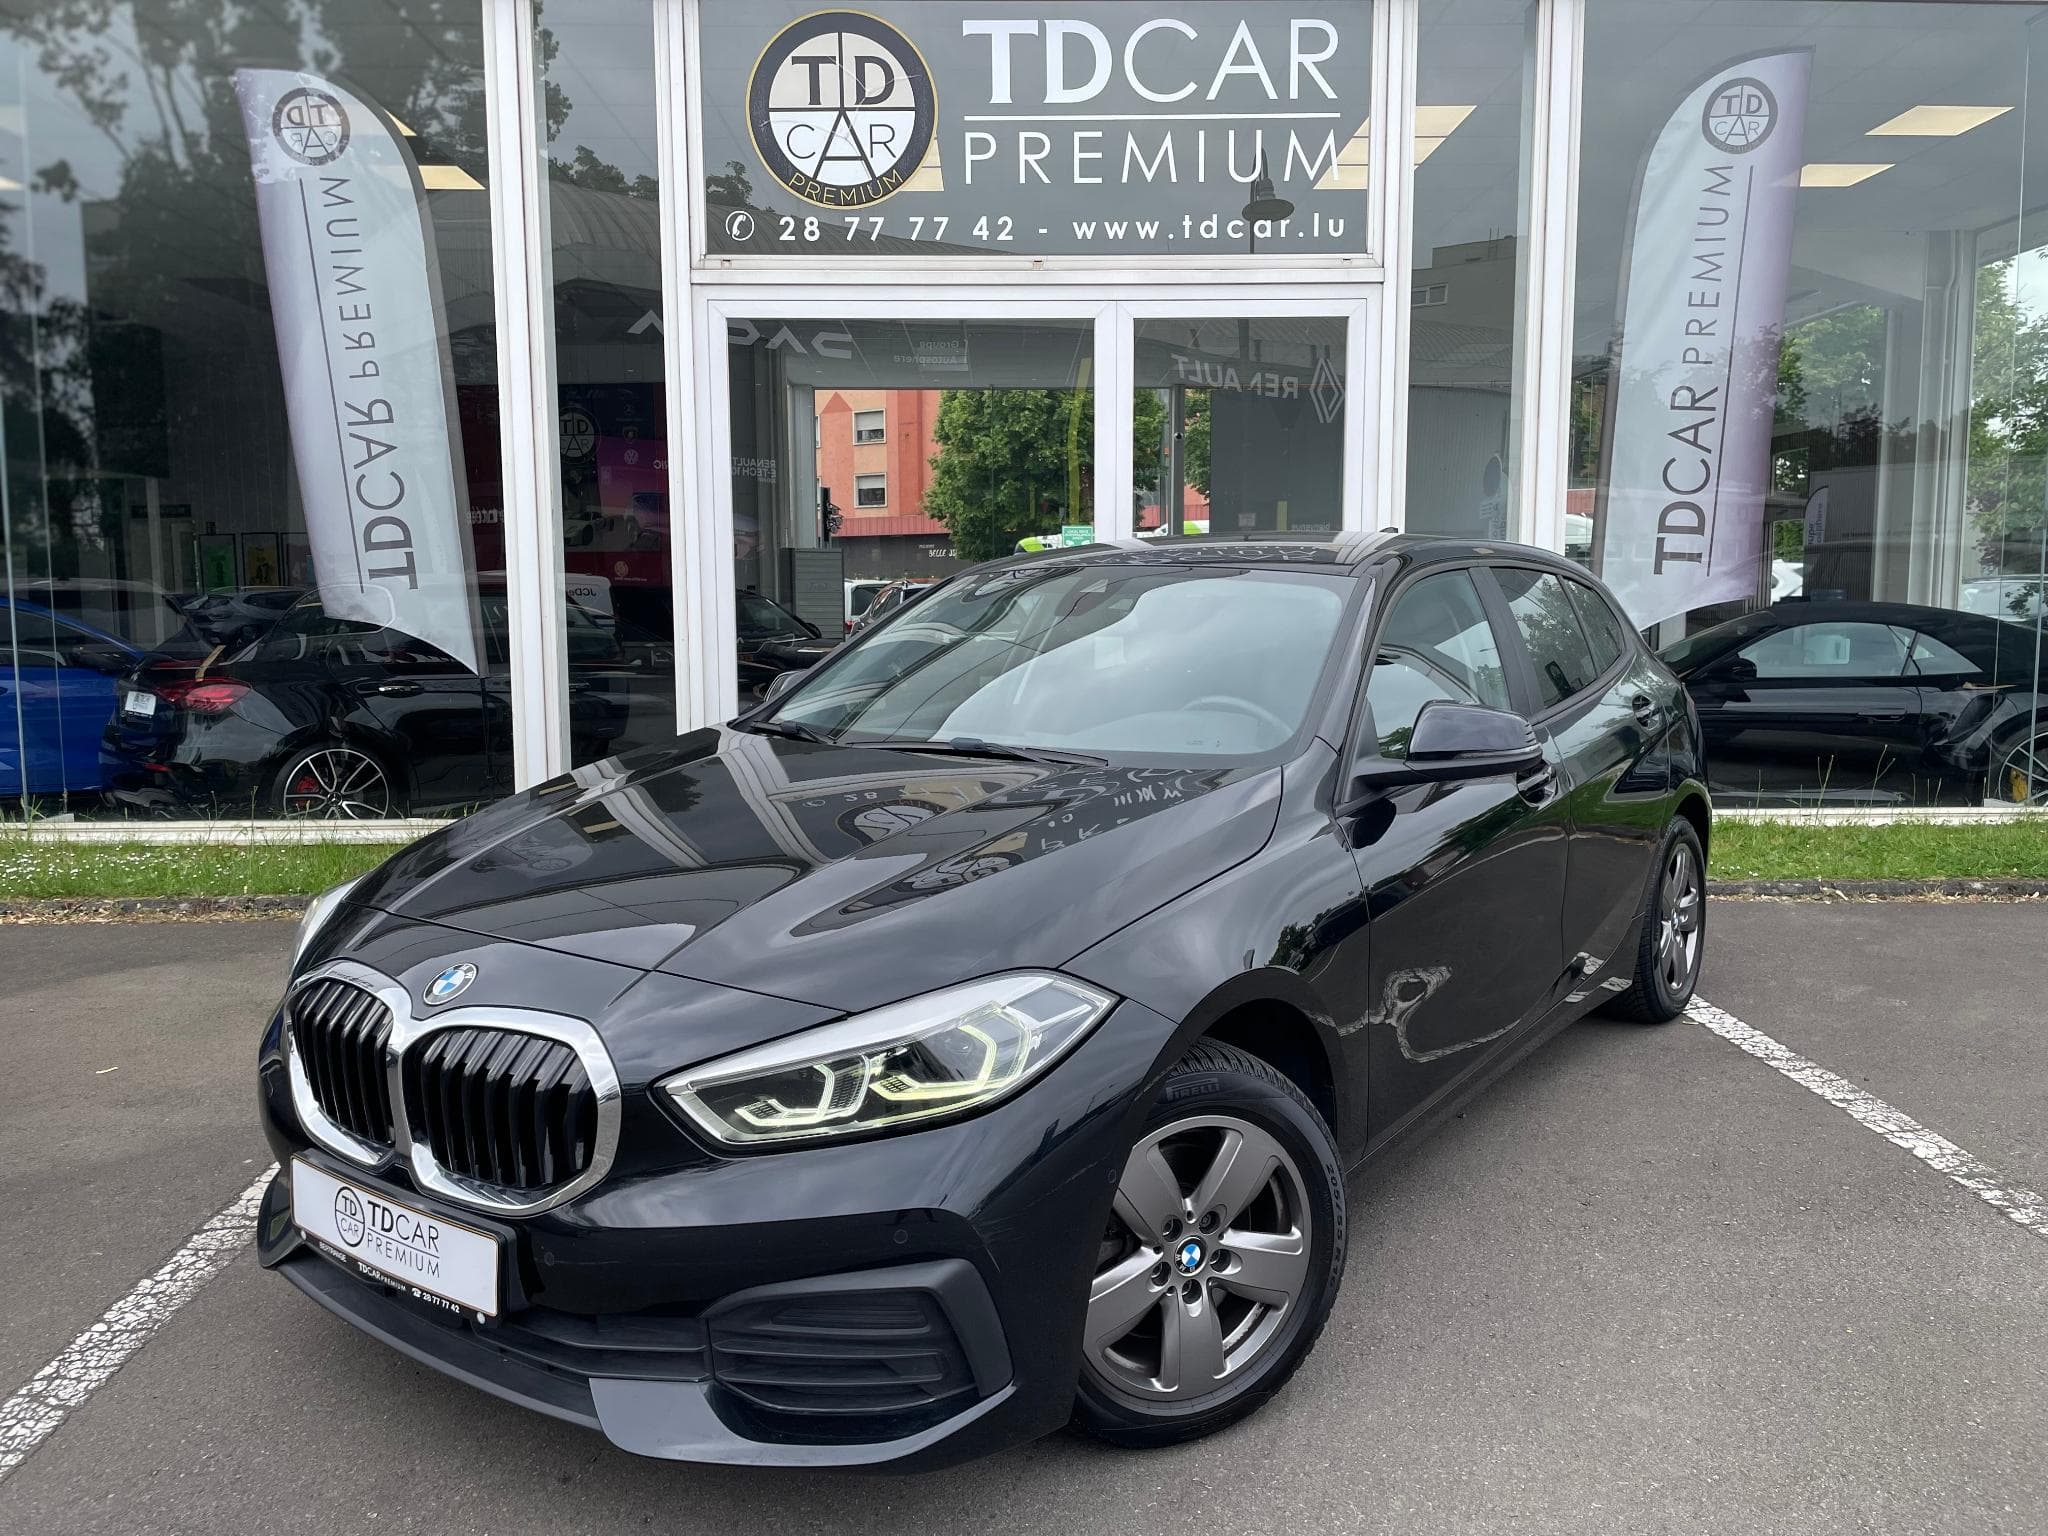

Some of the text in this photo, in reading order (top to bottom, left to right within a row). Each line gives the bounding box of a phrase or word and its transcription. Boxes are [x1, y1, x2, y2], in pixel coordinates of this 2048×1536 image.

[791, 55, 895, 106] TD
[962, 18, 1340, 104] TDCAR
[786, 110, 897, 180] CAR
[963, 127, 1341, 185] PREMIUM
[788, 168, 904, 206] PREMIUM
[778, 216, 821, 242] 28
[844, 216, 885, 242] 77
[909, 216, 949, 242] 77
[971, 216, 1014, 242] 42
[1072, 212, 1346, 241] www.tdcar.lu
[1682, 164, 1735, 367] PREMIUM
[340, 1218, 360, 1238] CAR
[341, 1195, 358, 1217] TD
[367, 1200, 440, 1253] TDCAR
[367, 1232, 441, 1279] PREMIUM
